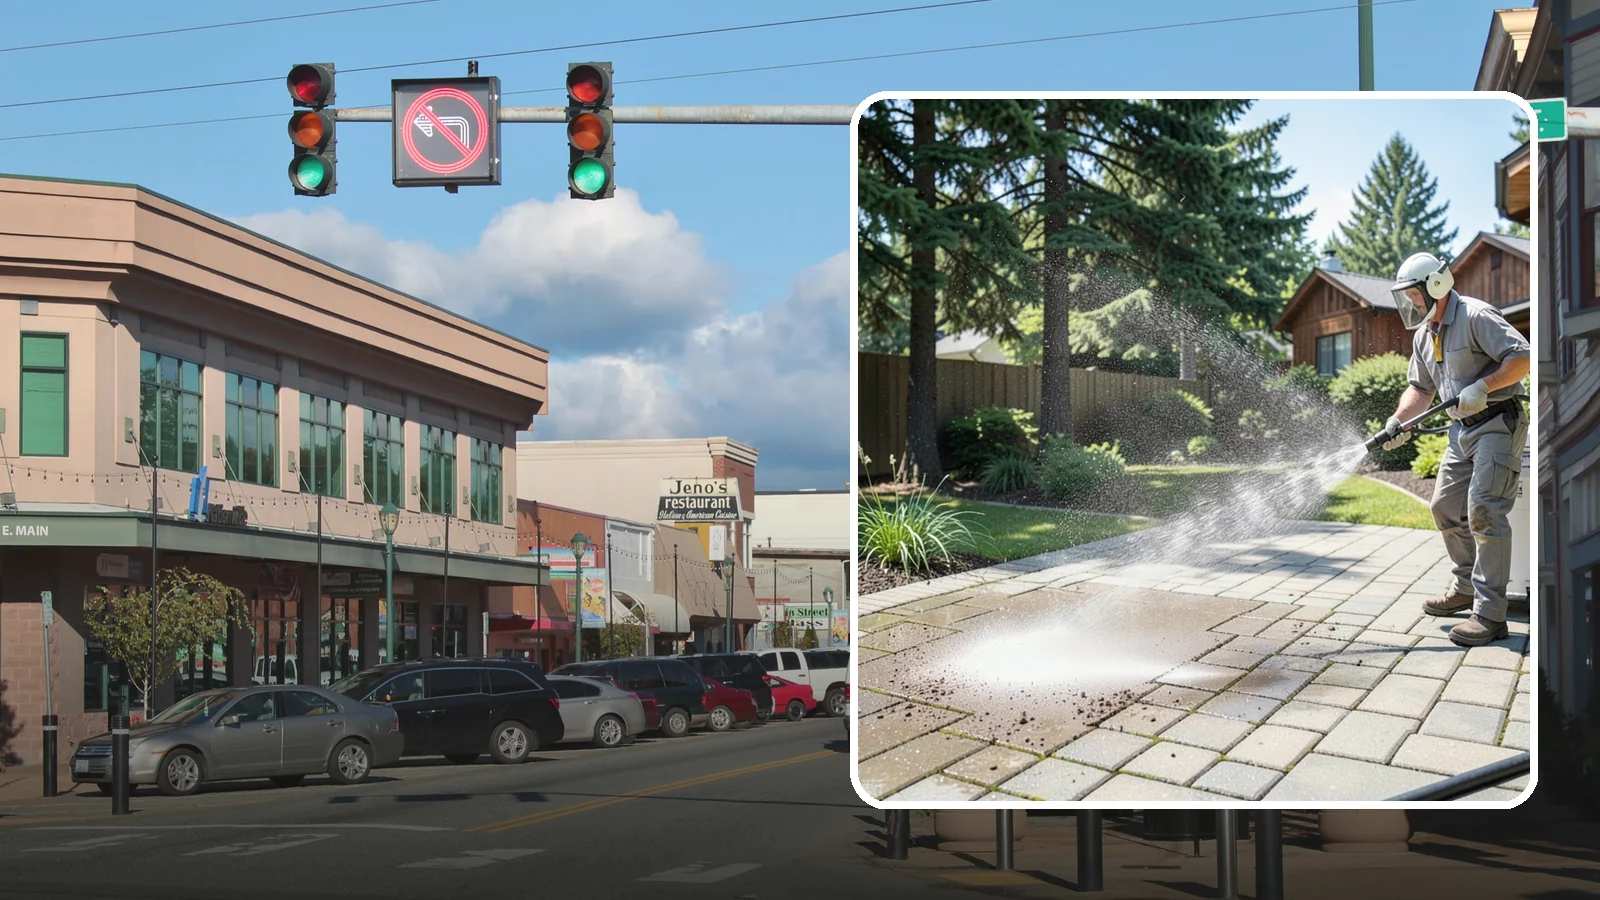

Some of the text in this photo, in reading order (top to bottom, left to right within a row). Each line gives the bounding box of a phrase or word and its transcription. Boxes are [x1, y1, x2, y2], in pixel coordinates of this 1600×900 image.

[669, 480, 728, 495] Jeno's
[665, 496, 731, 509] restaurant
[658, 509, 681, 520] Italian
[686, 509, 715, 519] American
[715, 509, 737, 519] Cuisine
[2, 525, 49, 536] E. MAIN
[797, 607, 828, 616] Street
